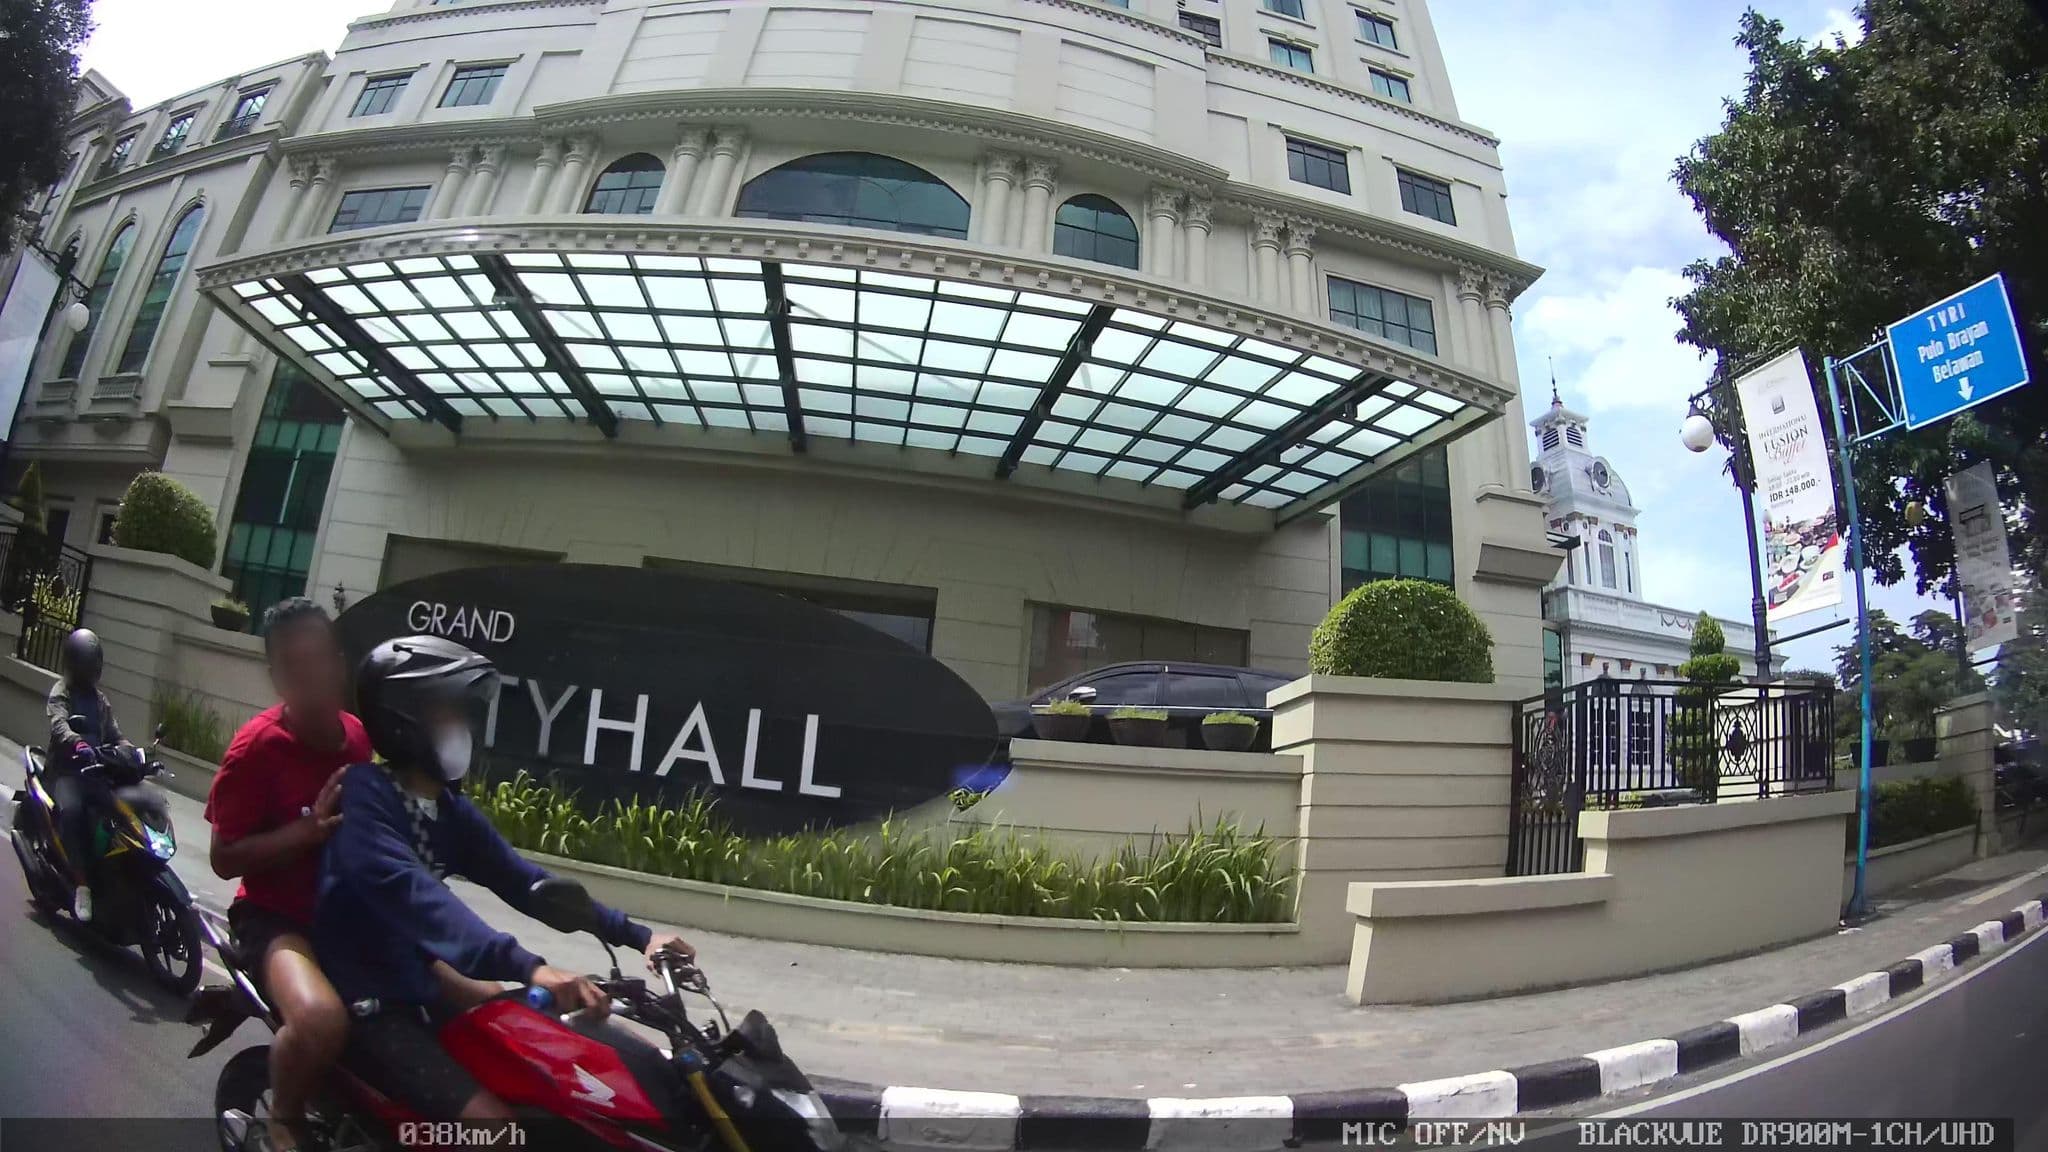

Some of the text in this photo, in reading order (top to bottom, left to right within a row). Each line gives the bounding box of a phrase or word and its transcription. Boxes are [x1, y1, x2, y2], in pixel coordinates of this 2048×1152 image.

[1926, 302, 1966, 332] TVRI
[1917, 320, 1990, 364] Pulo Brayan
[1932, 350, 1985, 384] Belawan
[1758, 413, 1808, 440] INTERNATIONAL
[1763, 423, 1809, 453] FUSION
[1769, 490, 1784, 503] IDR
[407, 600, 515, 643] GRAND
[483, 674, 842, 798] TYHALL
